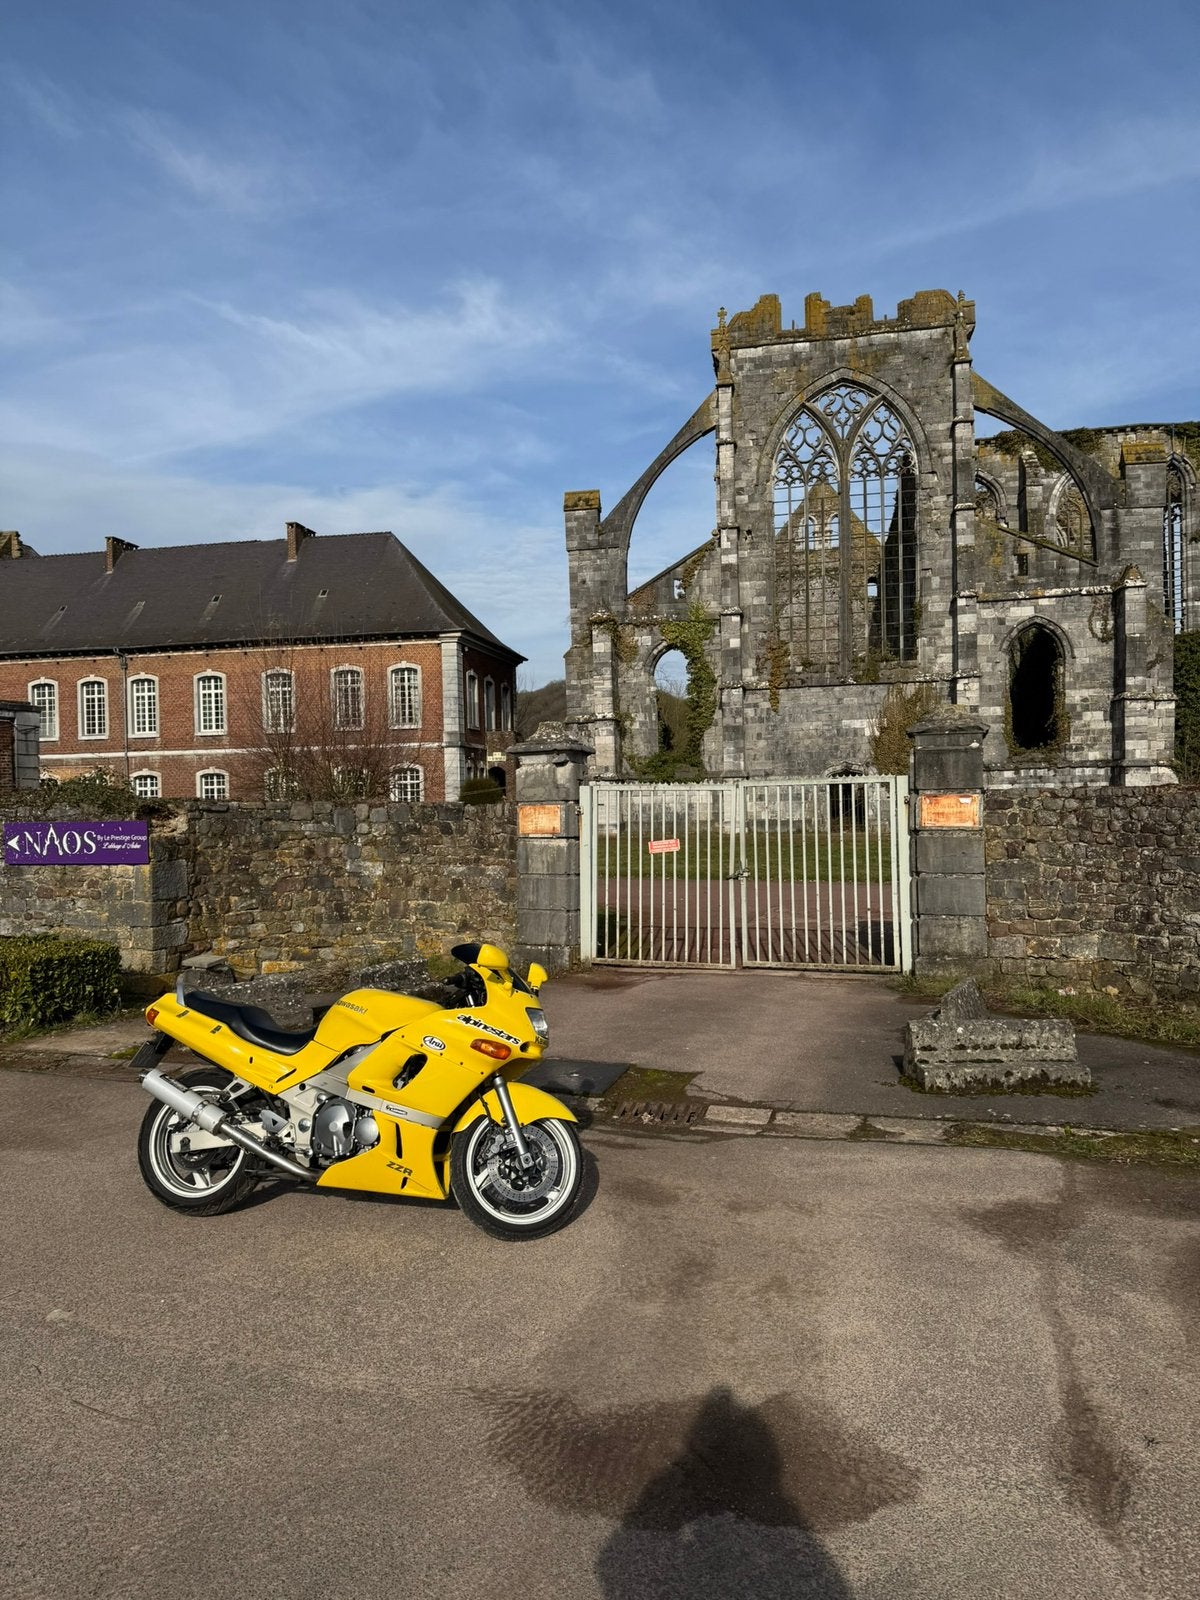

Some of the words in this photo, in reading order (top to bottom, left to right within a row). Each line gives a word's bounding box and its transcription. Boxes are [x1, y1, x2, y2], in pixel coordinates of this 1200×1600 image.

[24, 823, 96, 855] NAOS
[97, 834, 104, 842] By
[110, 834, 131, 842] Prestige
[131, 834, 147, 842] Group
[457, 1013, 521, 1045] alpinestars
[386, 1160, 413, 1177] ZZR
